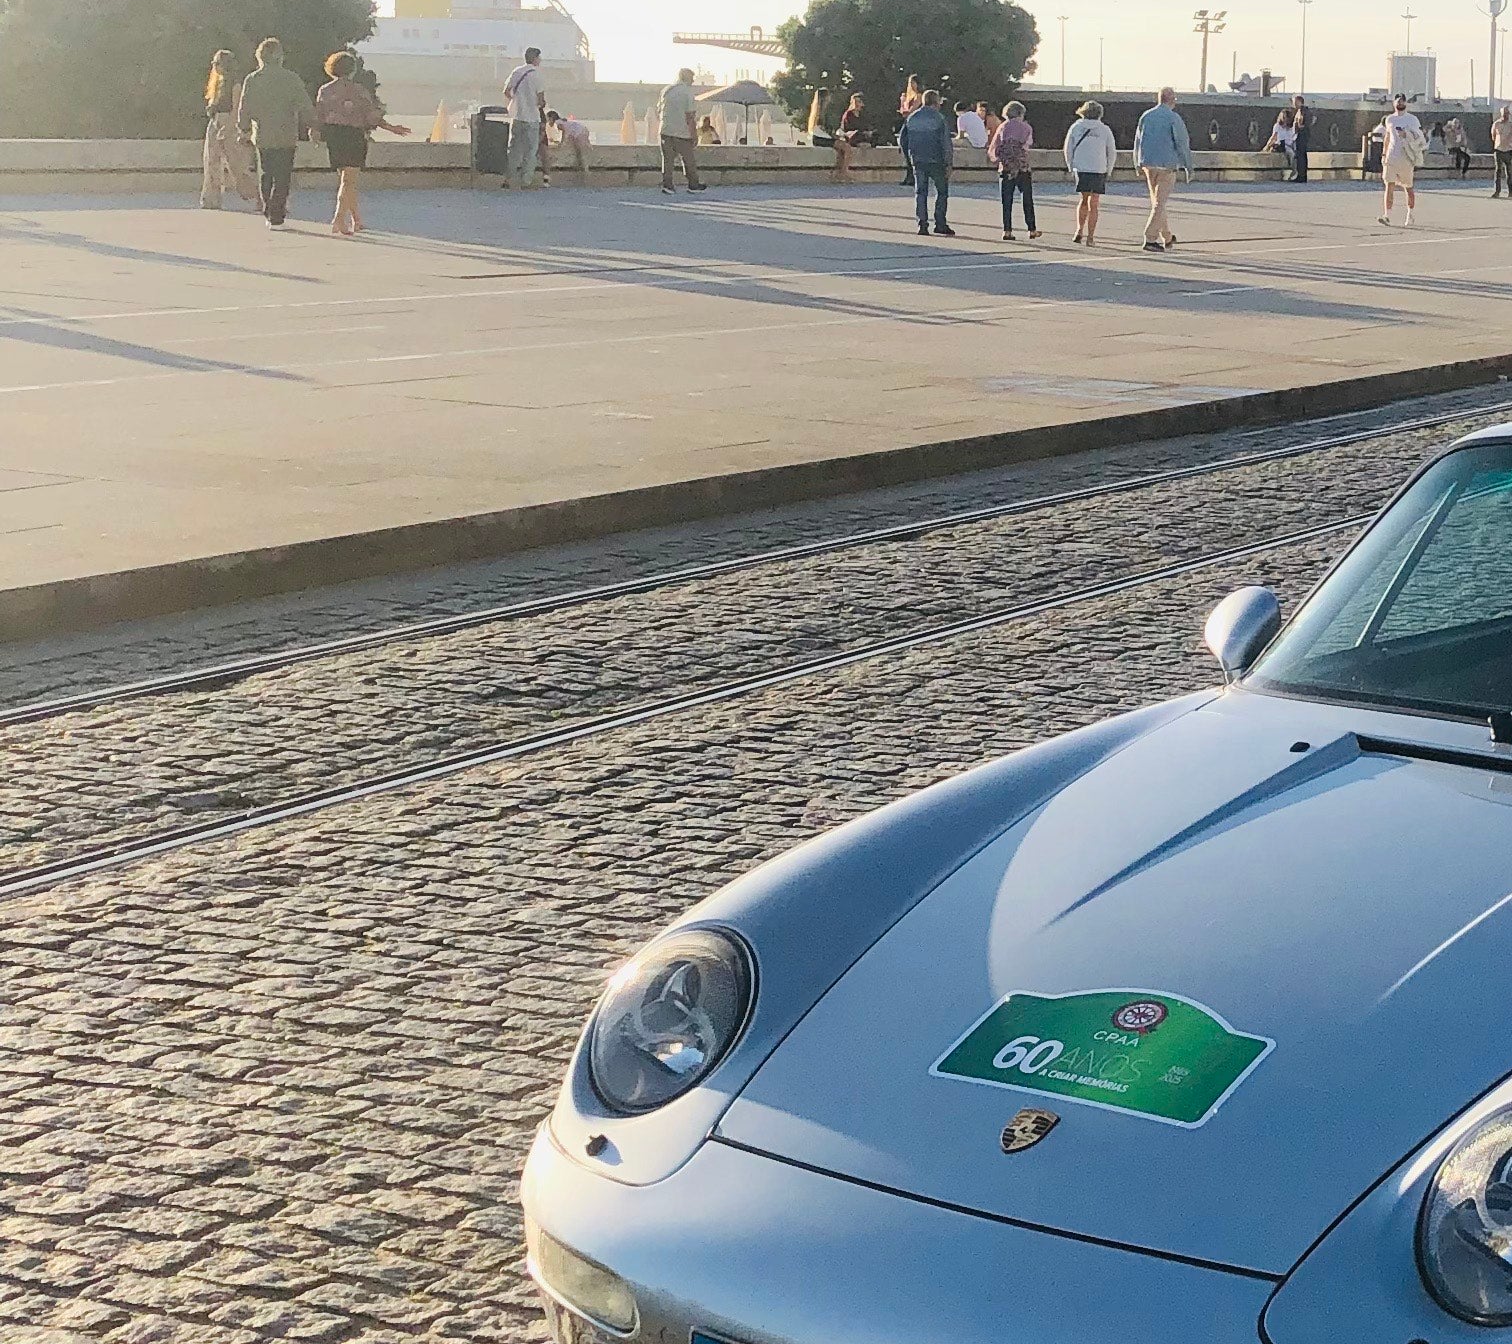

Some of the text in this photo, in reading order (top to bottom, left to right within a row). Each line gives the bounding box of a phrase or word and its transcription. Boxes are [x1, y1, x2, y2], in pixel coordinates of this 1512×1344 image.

[1093, 1030, 1140, 1048] CPAA
[992, 1035, 1152, 1083] 60 ANOS
[1038, 1068, 1049, 1077] A
[1047, 1070, 1078, 1083] CRIAR
